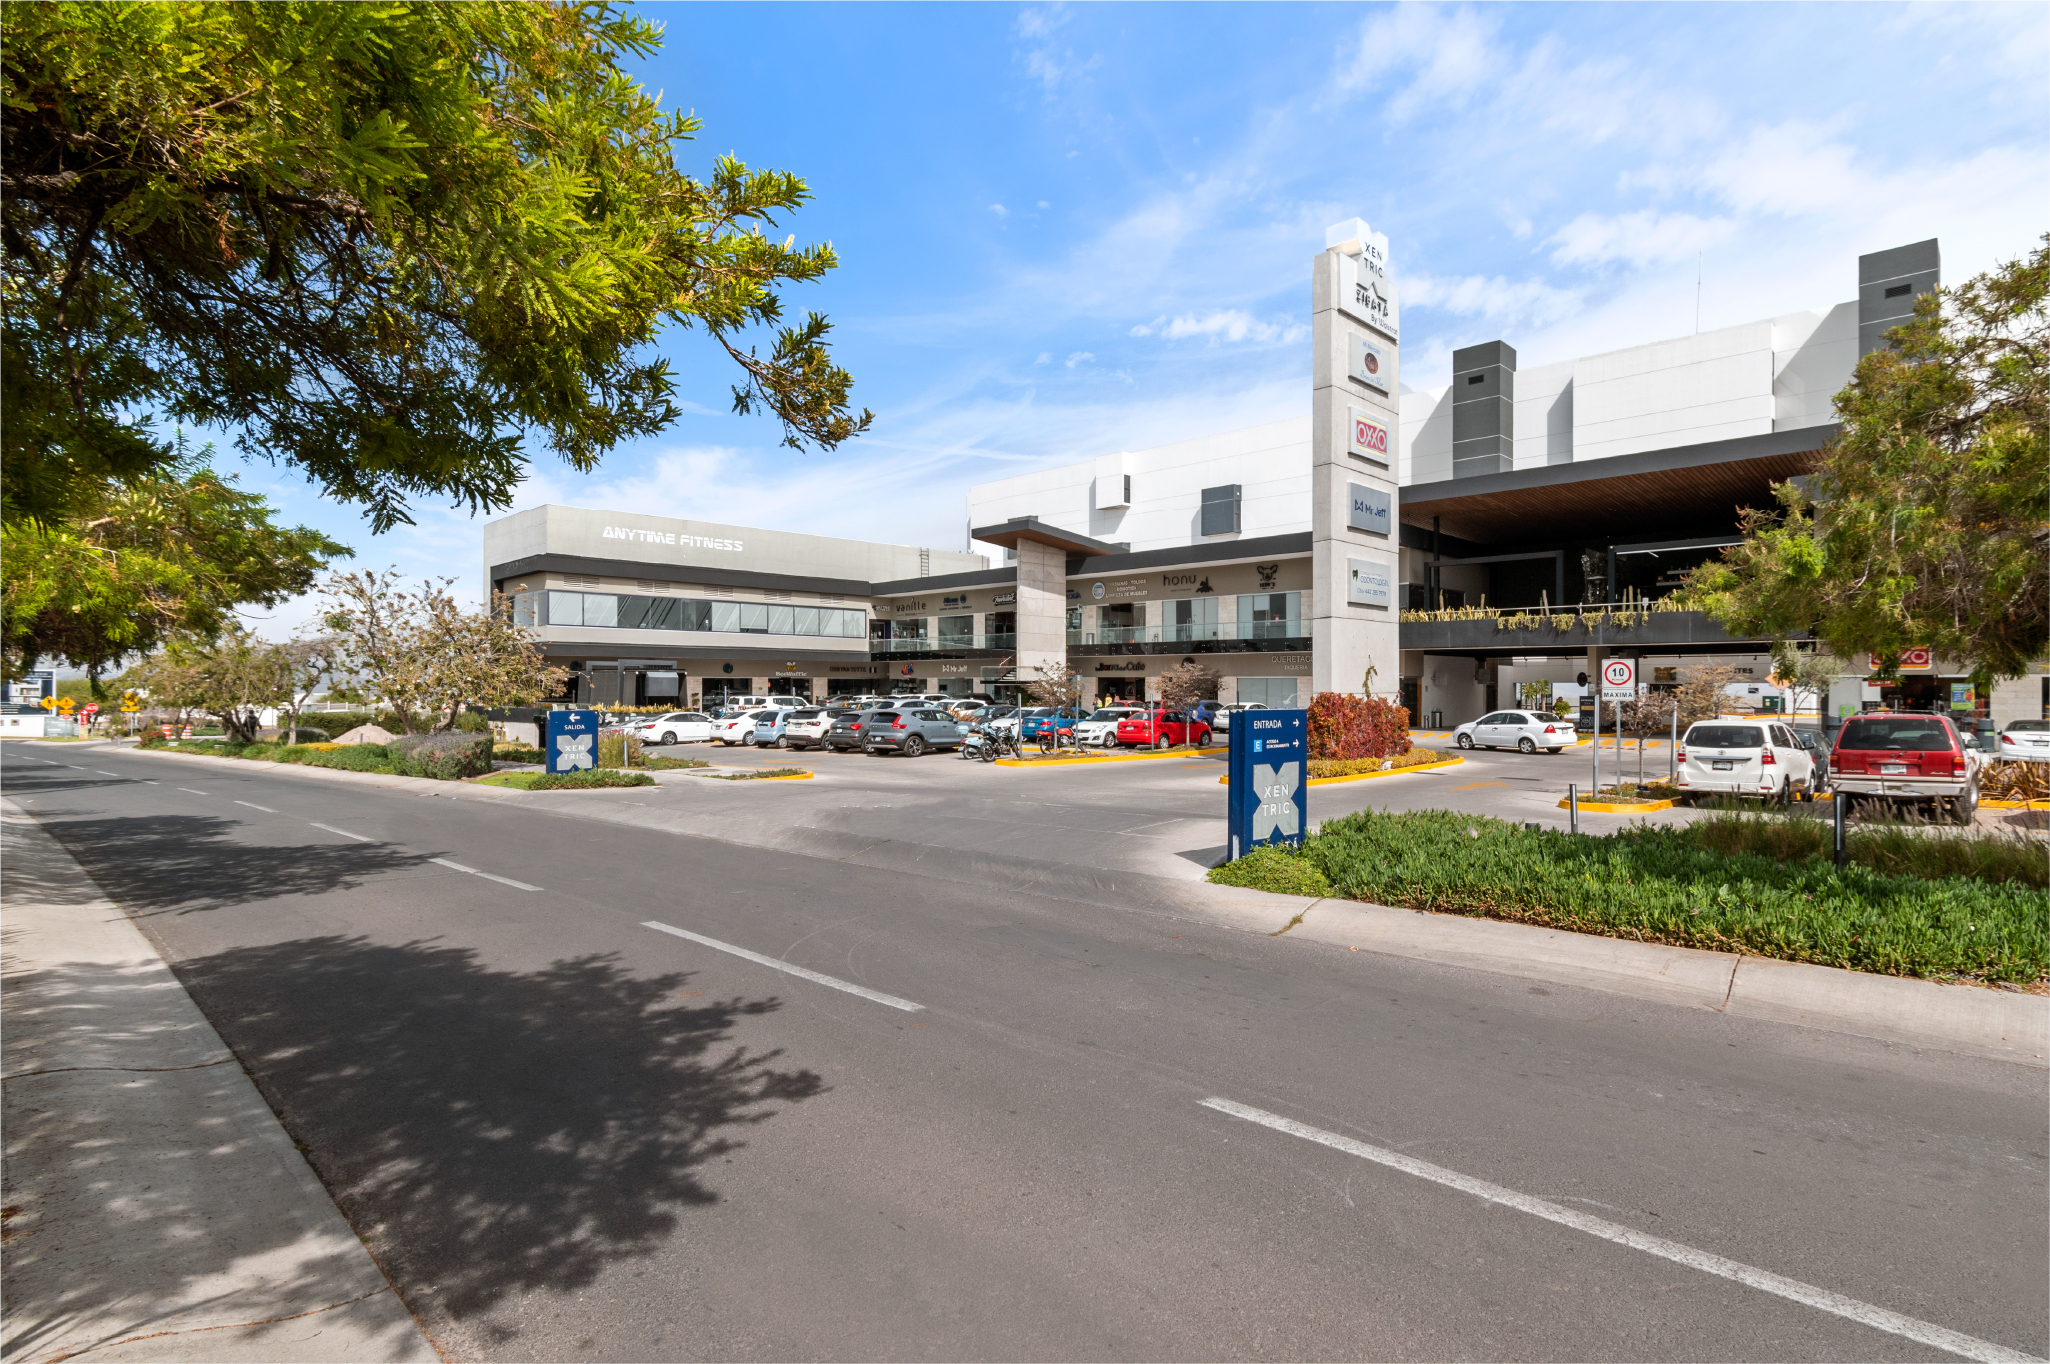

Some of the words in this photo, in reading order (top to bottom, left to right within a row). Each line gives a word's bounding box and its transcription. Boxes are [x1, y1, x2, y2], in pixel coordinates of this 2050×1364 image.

[1365, 242, 1383, 261] XEN
[1363, 257, 1383, 278] TRIC
[1357, 423, 1387, 450] OXXO
[1365, 504, 1374, 516] Mr
[1375, 507, 1387, 518] Jeff
[602, 526, 675, 545] ANYTIME
[680, 535, 744, 552] FITNESS
[1163, 575, 1197, 586] honu
[1612, 667, 1624, 677] 10
[1253, 720, 1282, 730] ENTRADA
[564, 744, 585, 752] XEN
[1255, 741, 1260, 750] E
[1263, 783, 1290, 799] XEN
[1262, 801, 1291, 817] TRIC
